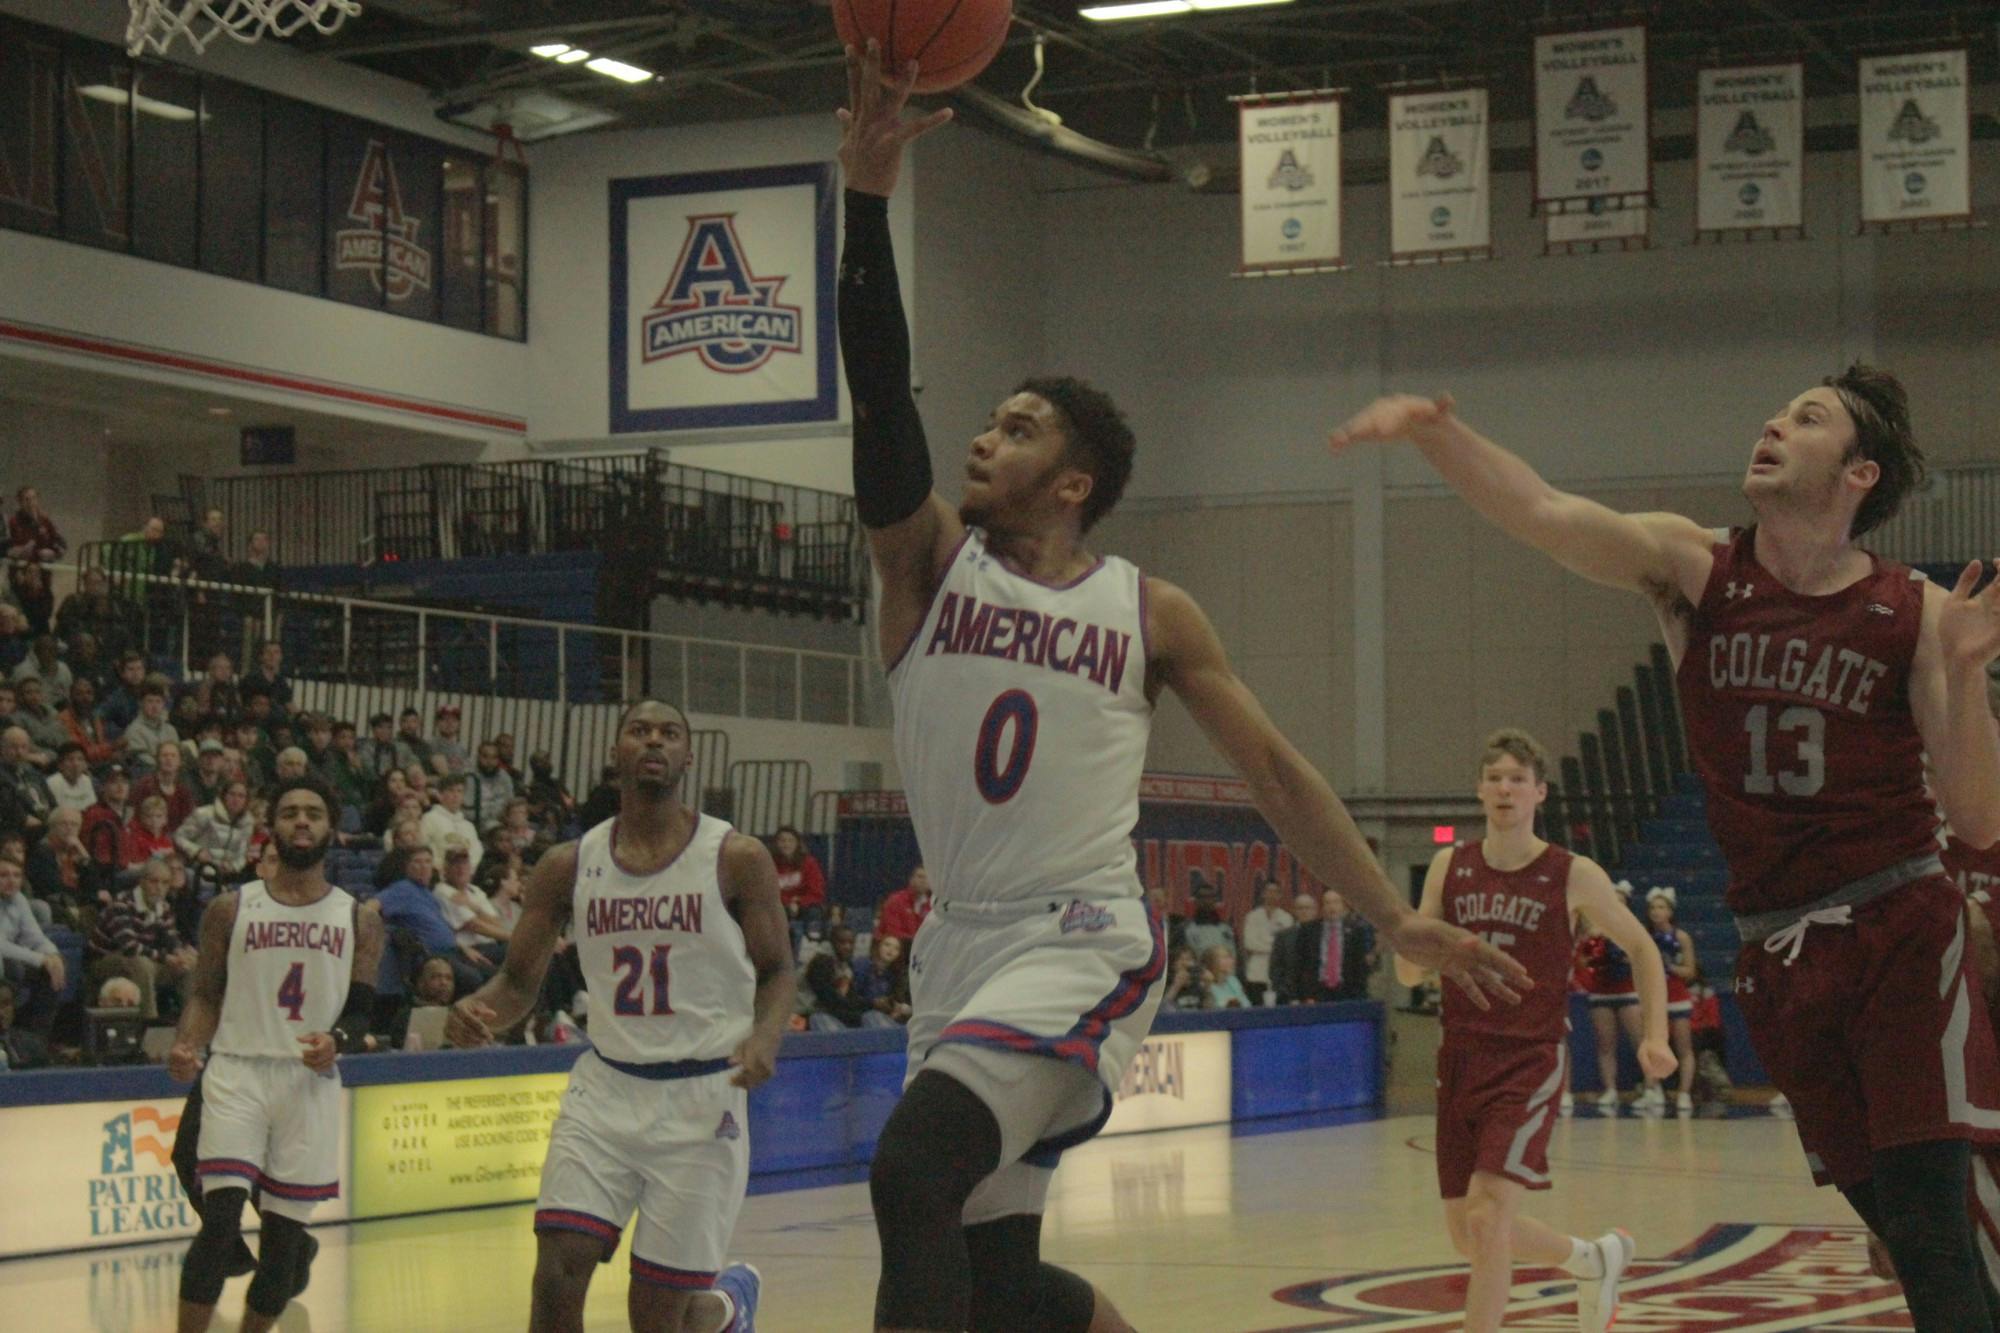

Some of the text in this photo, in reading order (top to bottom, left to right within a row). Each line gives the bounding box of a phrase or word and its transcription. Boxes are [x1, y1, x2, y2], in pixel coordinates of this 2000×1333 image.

[1247, 128, 1334, 144] VOLLEYBALL
[1575, 176, 1611, 190] 2017
[342, 236, 427, 280] AMEICAN
[653, 314, 791, 346] AMERICAN
[925, 592, 1133, 695] AMERICAN
[1710, 632, 1888, 716] COLGATE
[974, 688, 1039, 805] 0
[1743, 705, 1826, 797] 13
[587, 893, 702, 937] AMERICAN
[1454, 893, 1546, 932] COLGATE
[244, 921, 346, 959] AMERICAN
[277, 962, 306, 1021] 4
[612, 944, 676, 1017] 21
[382, 1112, 438, 1130] GLOVER
[392, 1136, 428, 1150] PARK
[387, 1157, 432, 1173] HOTEL
[90, 1201, 198, 1237] LEAGU
